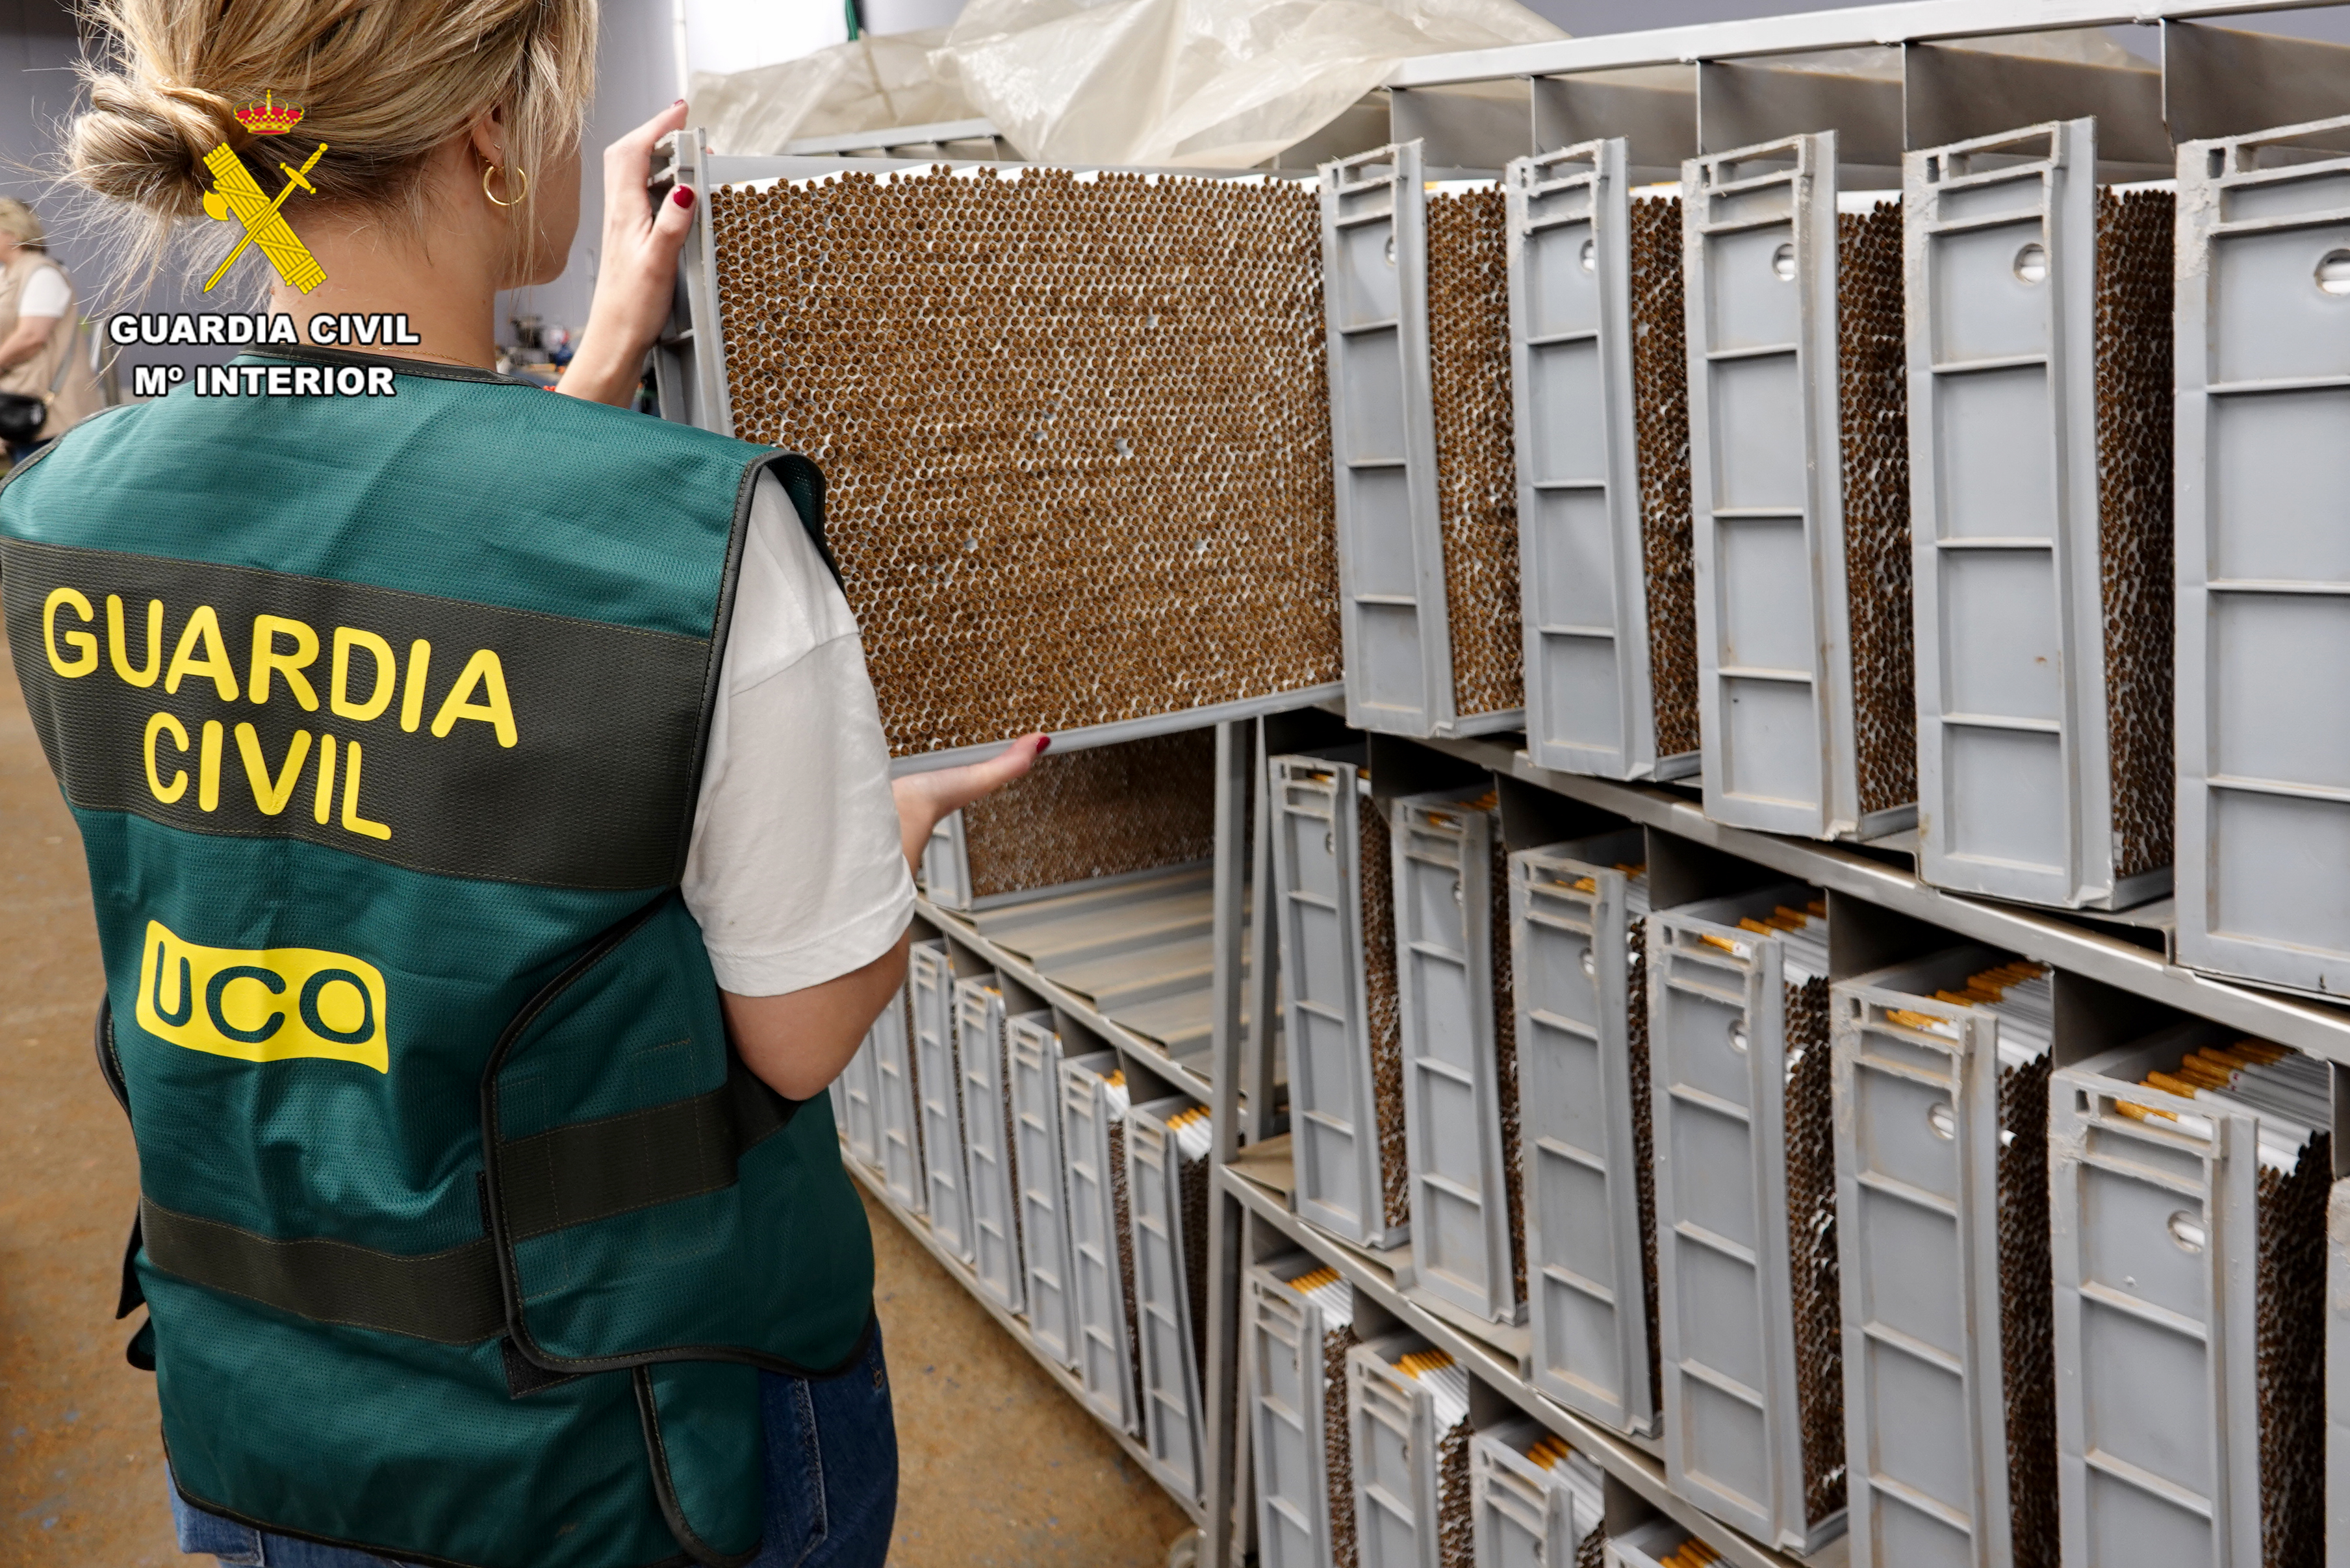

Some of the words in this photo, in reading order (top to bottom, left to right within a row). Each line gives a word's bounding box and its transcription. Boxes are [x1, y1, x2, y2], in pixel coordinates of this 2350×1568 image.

[43, 587, 518, 748] GUARDIA
[144, 711, 392, 841] CIVIL
[153, 941, 376, 1044] UCO
